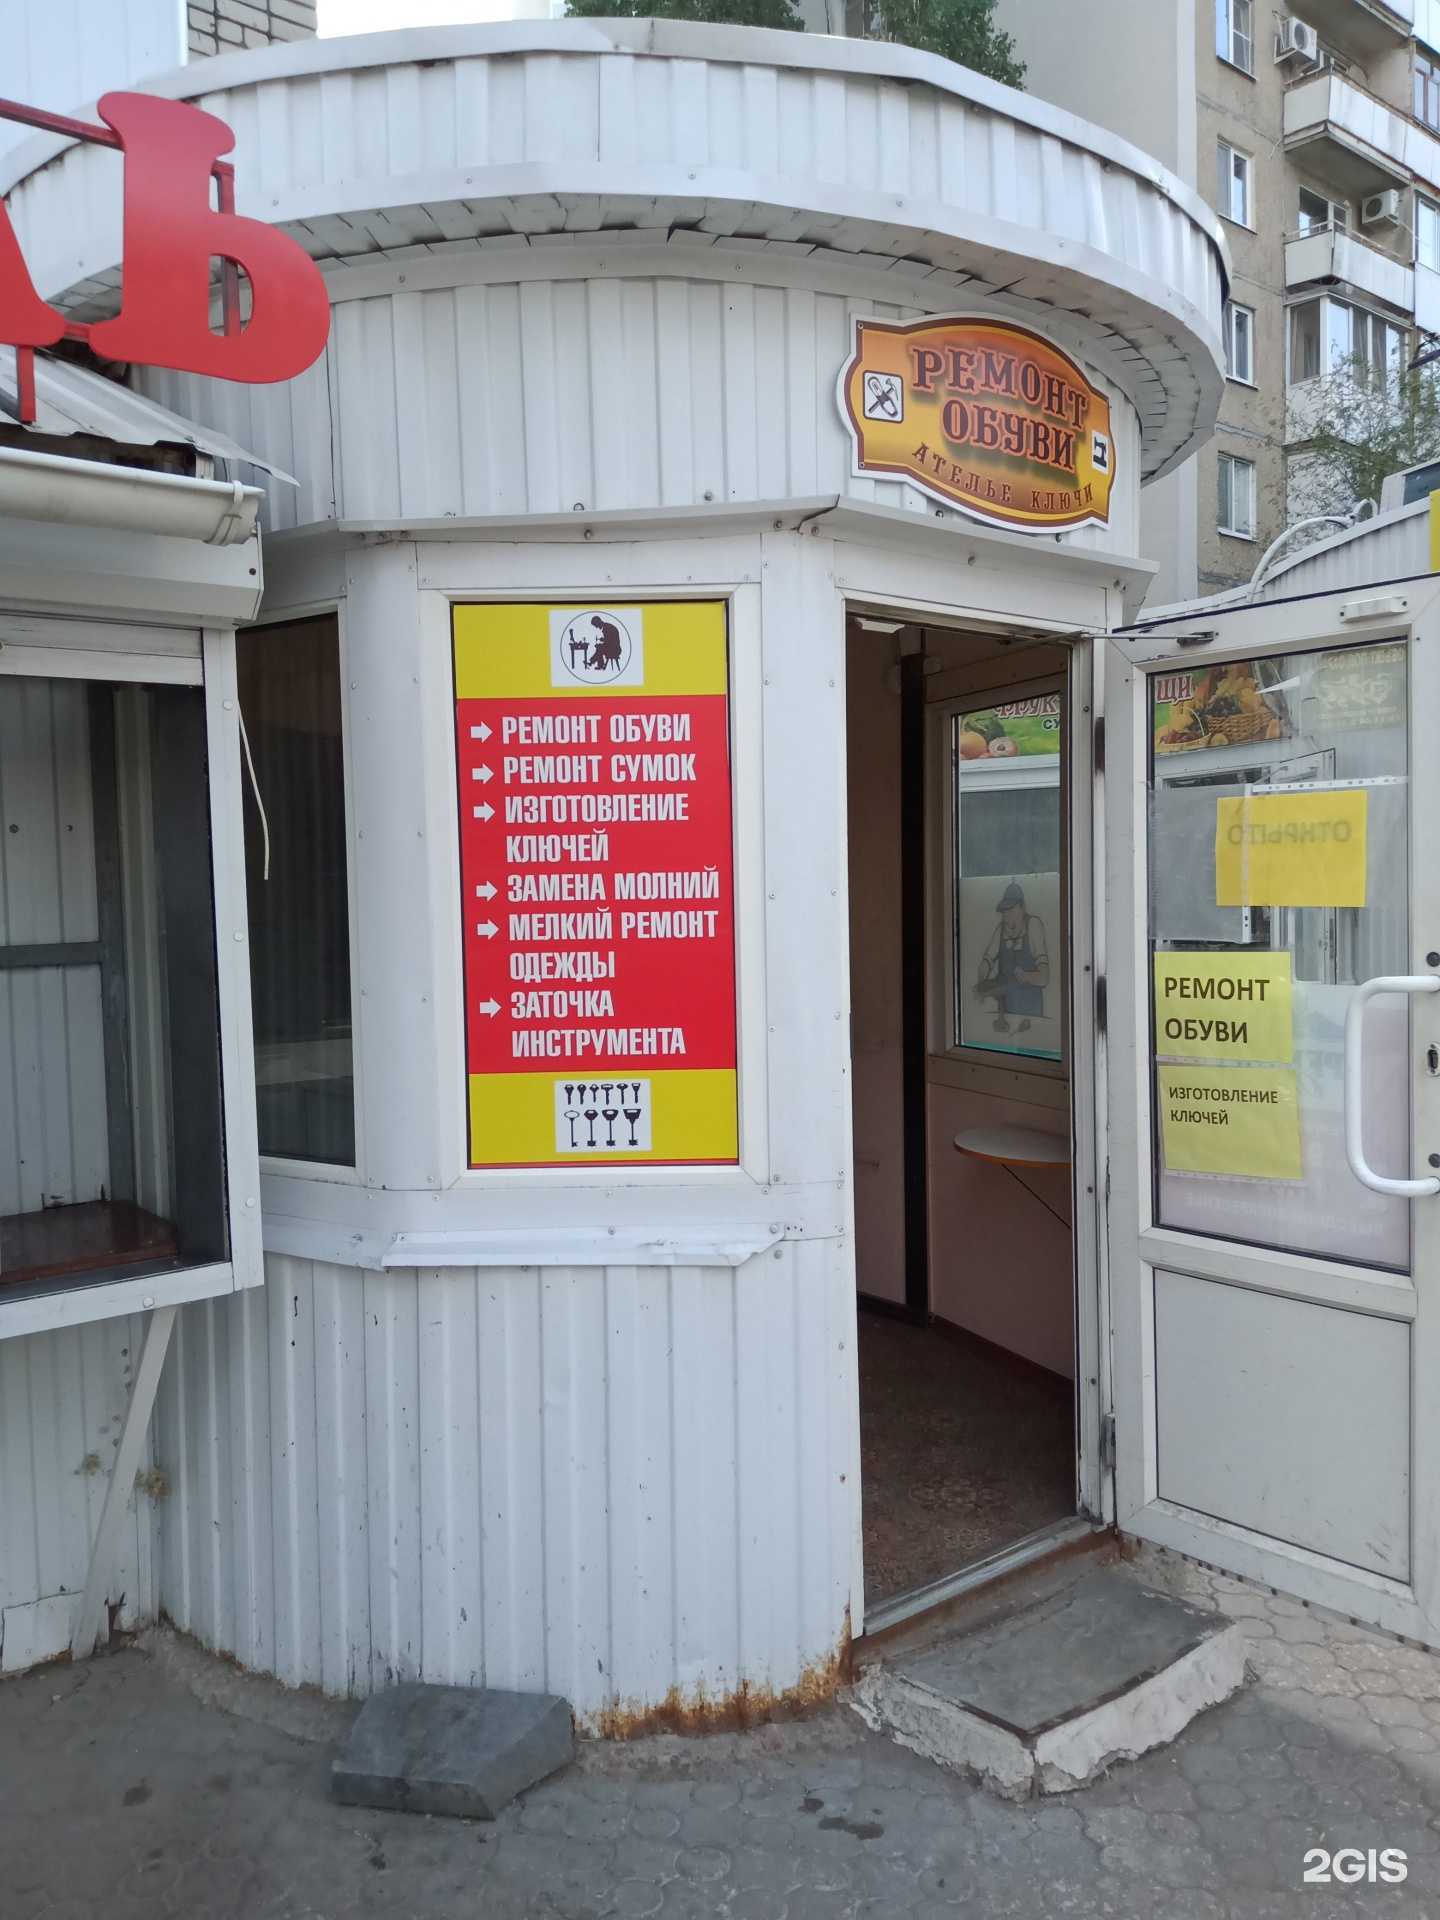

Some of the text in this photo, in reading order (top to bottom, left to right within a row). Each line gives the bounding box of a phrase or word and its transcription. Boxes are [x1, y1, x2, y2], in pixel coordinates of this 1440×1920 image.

[0, 91, 330, 384] Ь
[911, 347, 1088, 430] РЕМОНТ
[942, 399, 1075, 471] ОБУВИ
[912, 442, 1093, 511] АТЕЛЬЕ КЛЮЧИ
[502, 714, 691, 744] РЕМОНТ ОБУВИ
[503, 753, 697, 784] РЕМОНТ СУМОК
[505, 794, 689, 824] ИЗГОТОВЛЕНИЕ
[506, 828, 609, 863] КЛЮЧЕЙ
[507, 865, 720, 902] ЗАМЕНА МОЛНИЙ
[508, 906, 719, 941] МЕЛКИЙ РЕМОНТ
[509, 951, 615, 983] ОДЕЖДЫ
[1164, 976, 1270, 1001] РЕМОНТ
[511, 990, 615, 1019] ЗАТОЧКА
[512, 1027, 687, 1058] ИНСТРУМЕНТА
[1164, 1018, 1249, 1043] ОБУВИ
[1169, 1087, 1279, 1104] ИЗГОТОВЛЕНИЕ
[1170, 1109, 1229, 1125] КЛЮЧЕЙ
